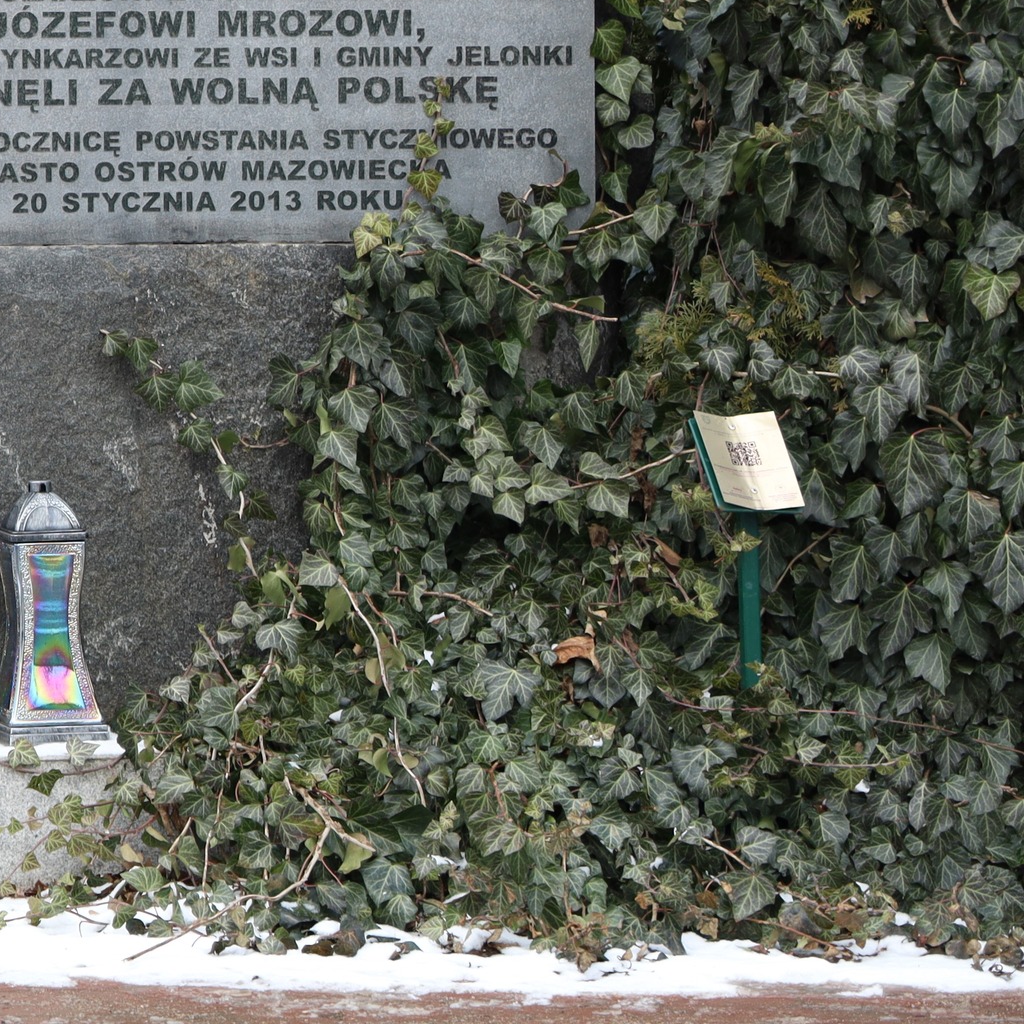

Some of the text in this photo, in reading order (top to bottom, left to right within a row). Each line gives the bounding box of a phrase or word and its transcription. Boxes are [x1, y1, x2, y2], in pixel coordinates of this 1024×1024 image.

[218, 9, 426, 43] MROZOWI,
[193, 47, 230, 68] ZE
[245, 46, 297, 68] WSI
[313, 47, 321, 68] I
[336, 46, 433, 68] GMINY
[446, 44, 574, 67] JELONKI
[98, 78, 152, 106] ZA
[170, 77, 320, 112] WOLNĄ
[337, 76, 499, 112] POLSKĘ
[136, 129, 309, 152] POWSTANIA
[322, 127, 558, 151] STYCZIOWEGO
[94, 157, 227, 183] OSTRÓW
[12, 189, 404, 214] 20 STYCZNIA 2013 ROKU
